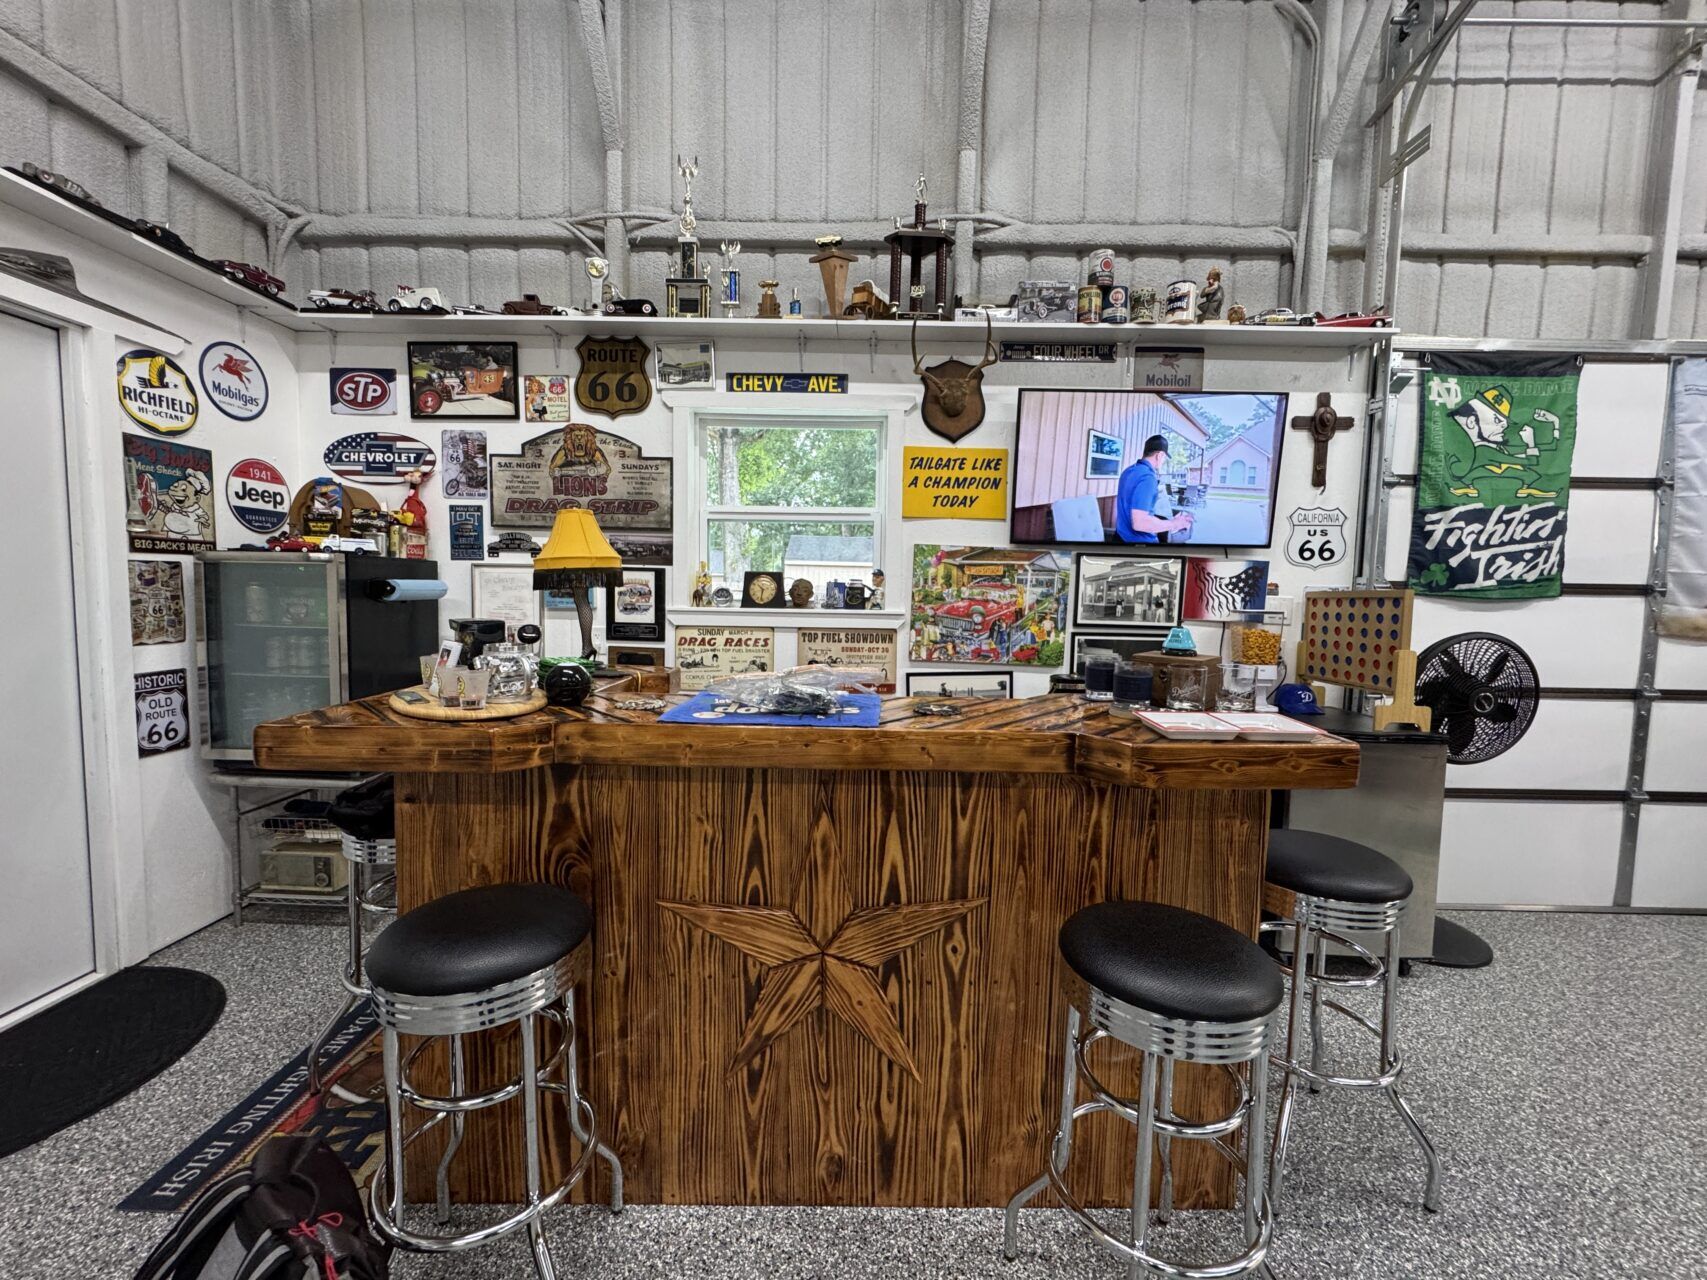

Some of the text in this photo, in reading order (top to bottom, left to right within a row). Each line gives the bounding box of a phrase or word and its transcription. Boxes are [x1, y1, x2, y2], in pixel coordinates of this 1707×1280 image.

[587, 348, 638, 363] ROUTE
[1033, 345, 1062, 360] FOUR
[1064, 345, 1100, 360] WHEEL
[588, 371, 638, 403] 66
[732, 375, 842, 393] CHEVY AVE.
[1145, 374, 1191, 387] Mobiloil
[212, 381, 260, 407] Mobilgas
[342, 377, 382, 403] STP
[1523, 380, 1574, 397] DAME
[122, 385, 195, 416] RICHFIELD
[138, 406, 185, 423] HI-OCTANE
[342, 453, 417, 463] CHEVROLET
[909, 456, 1003, 471] TAILGATE LIKE
[249, 467, 271, 481] 1941
[621, 463, 659, 471] SUNDAYS
[552, 474, 609, 497] LIONS
[908, 476, 1003, 490] A CHAMPION
[234, 481, 284, 509] Jeep
[932, 495, 980, 508] TODAY
[588, 498, 659, 516] STRIP
[450, 511, 481, 526] LOST
[1297, 513, 1340, 523] CALIFORNIA
[1307, 529, 1329, 537] US
[134, 539, 214, 552] BIG JACK'S MEAT!
[1298, 539, 1336, 562] 66
[1454, 535, 1563, 590] Irish
[152, 604, 164, 615] 66
[697, 628, 725, 636] SUNDAY
[801, 632, 894, 644] TOP FUEL SHOWDOWN
[678, 636, 770, 648] DRAG RACES
[134, 672, 185, 690] HISTORIC
[148, 696, 173, 710] OLD
[145, 708, 177, 721] ROUTE
[147, 720, 179, 745] 66
[152, 1140, 235, 1198] IRISH
